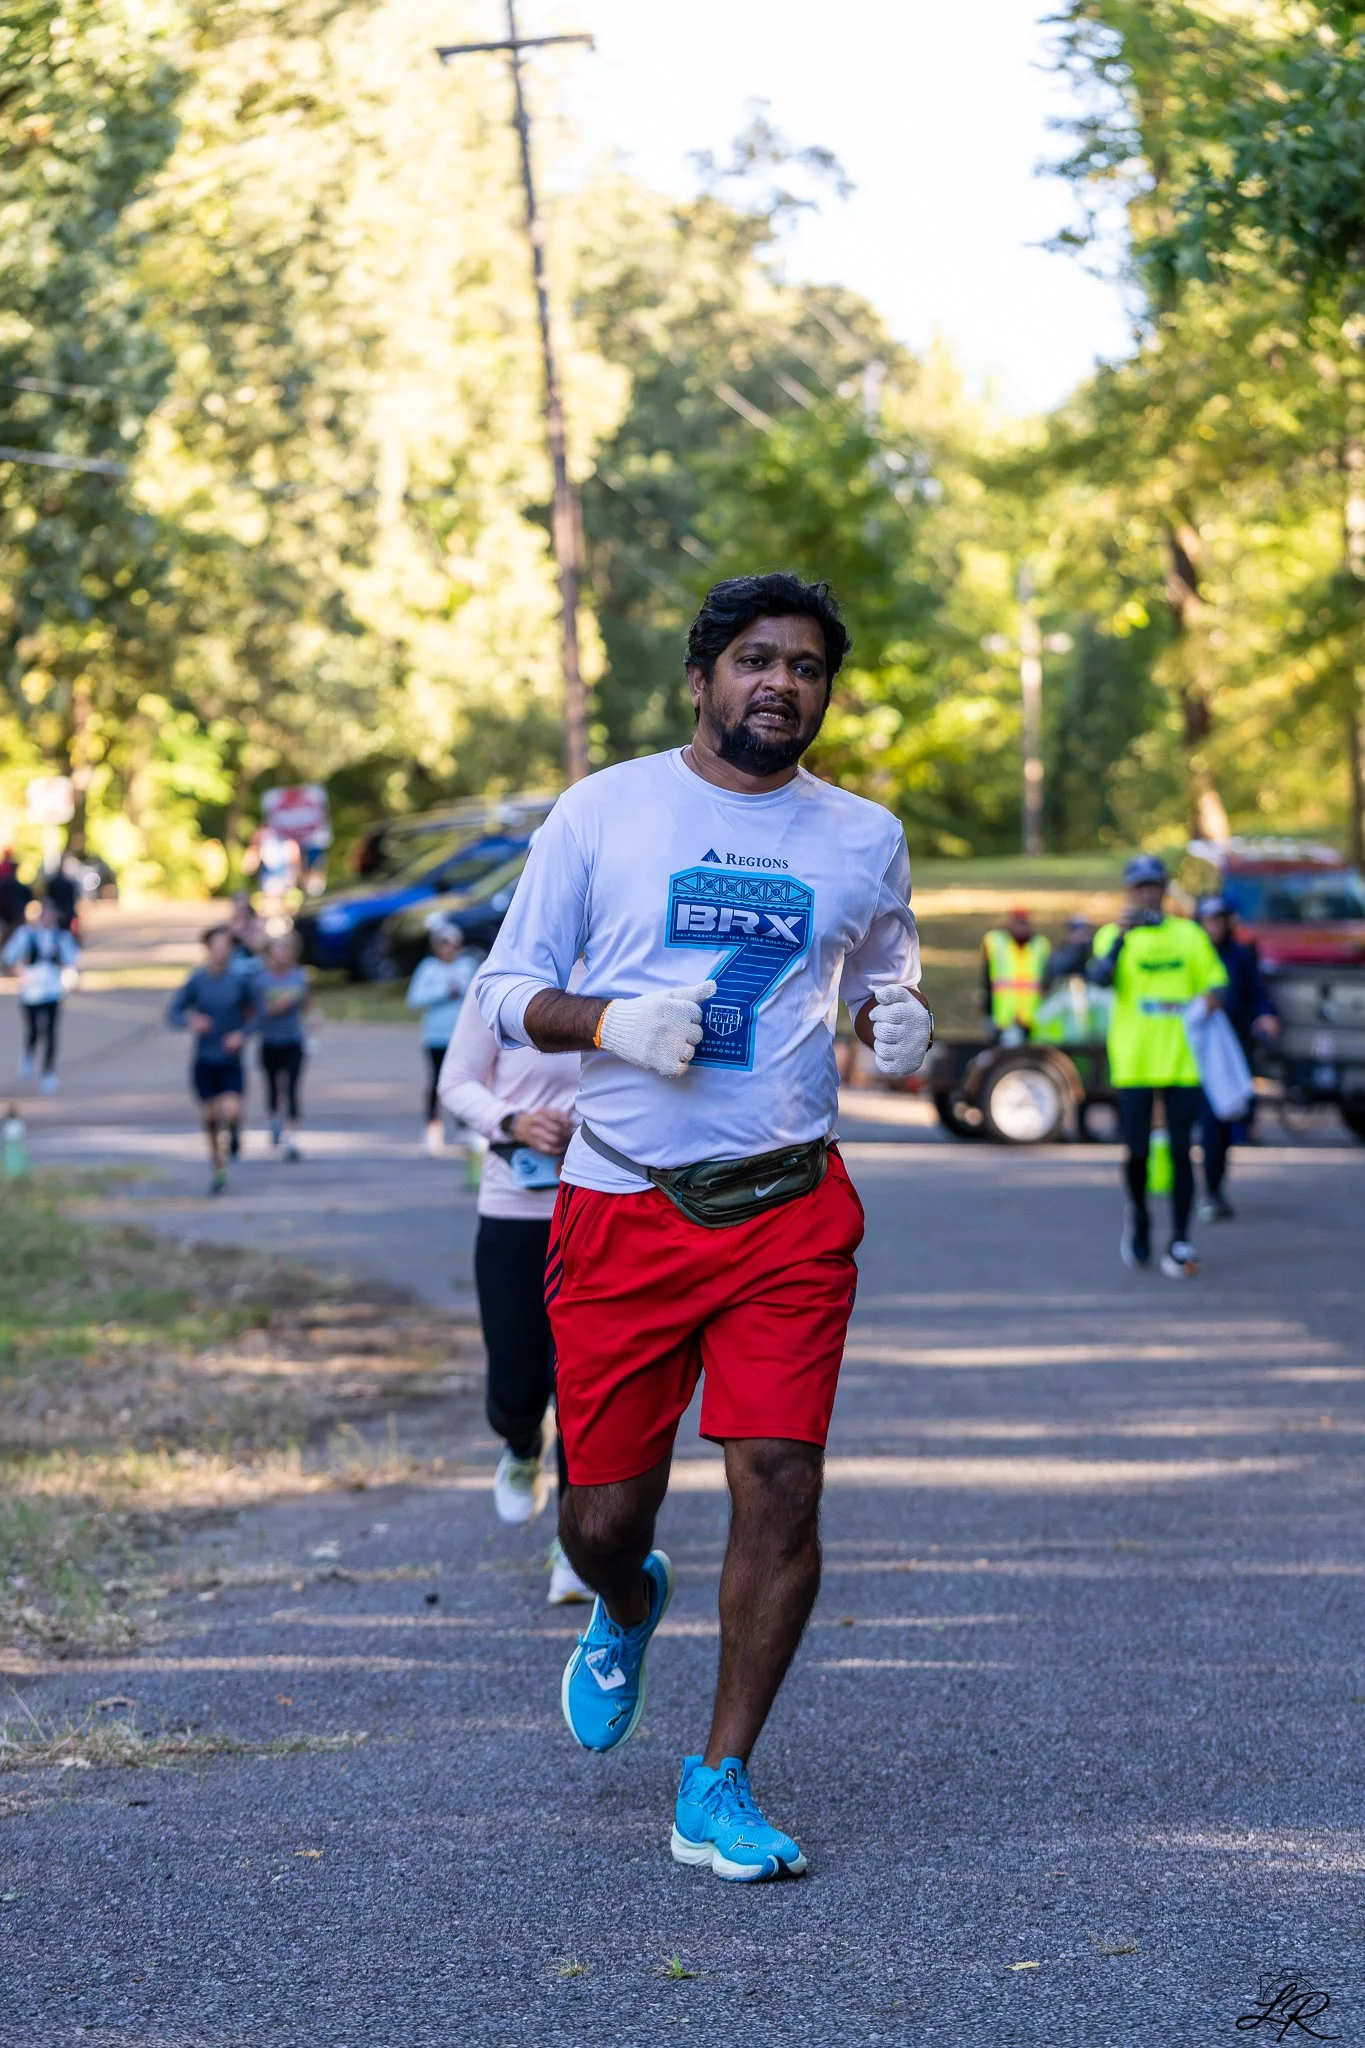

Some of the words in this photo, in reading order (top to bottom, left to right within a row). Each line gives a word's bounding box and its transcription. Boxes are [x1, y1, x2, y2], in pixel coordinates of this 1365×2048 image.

[725, 852, 789, 869] REGIONS
[676, 903, 803, 944] BRX
[710, 1011, 739, 1025] POWER
